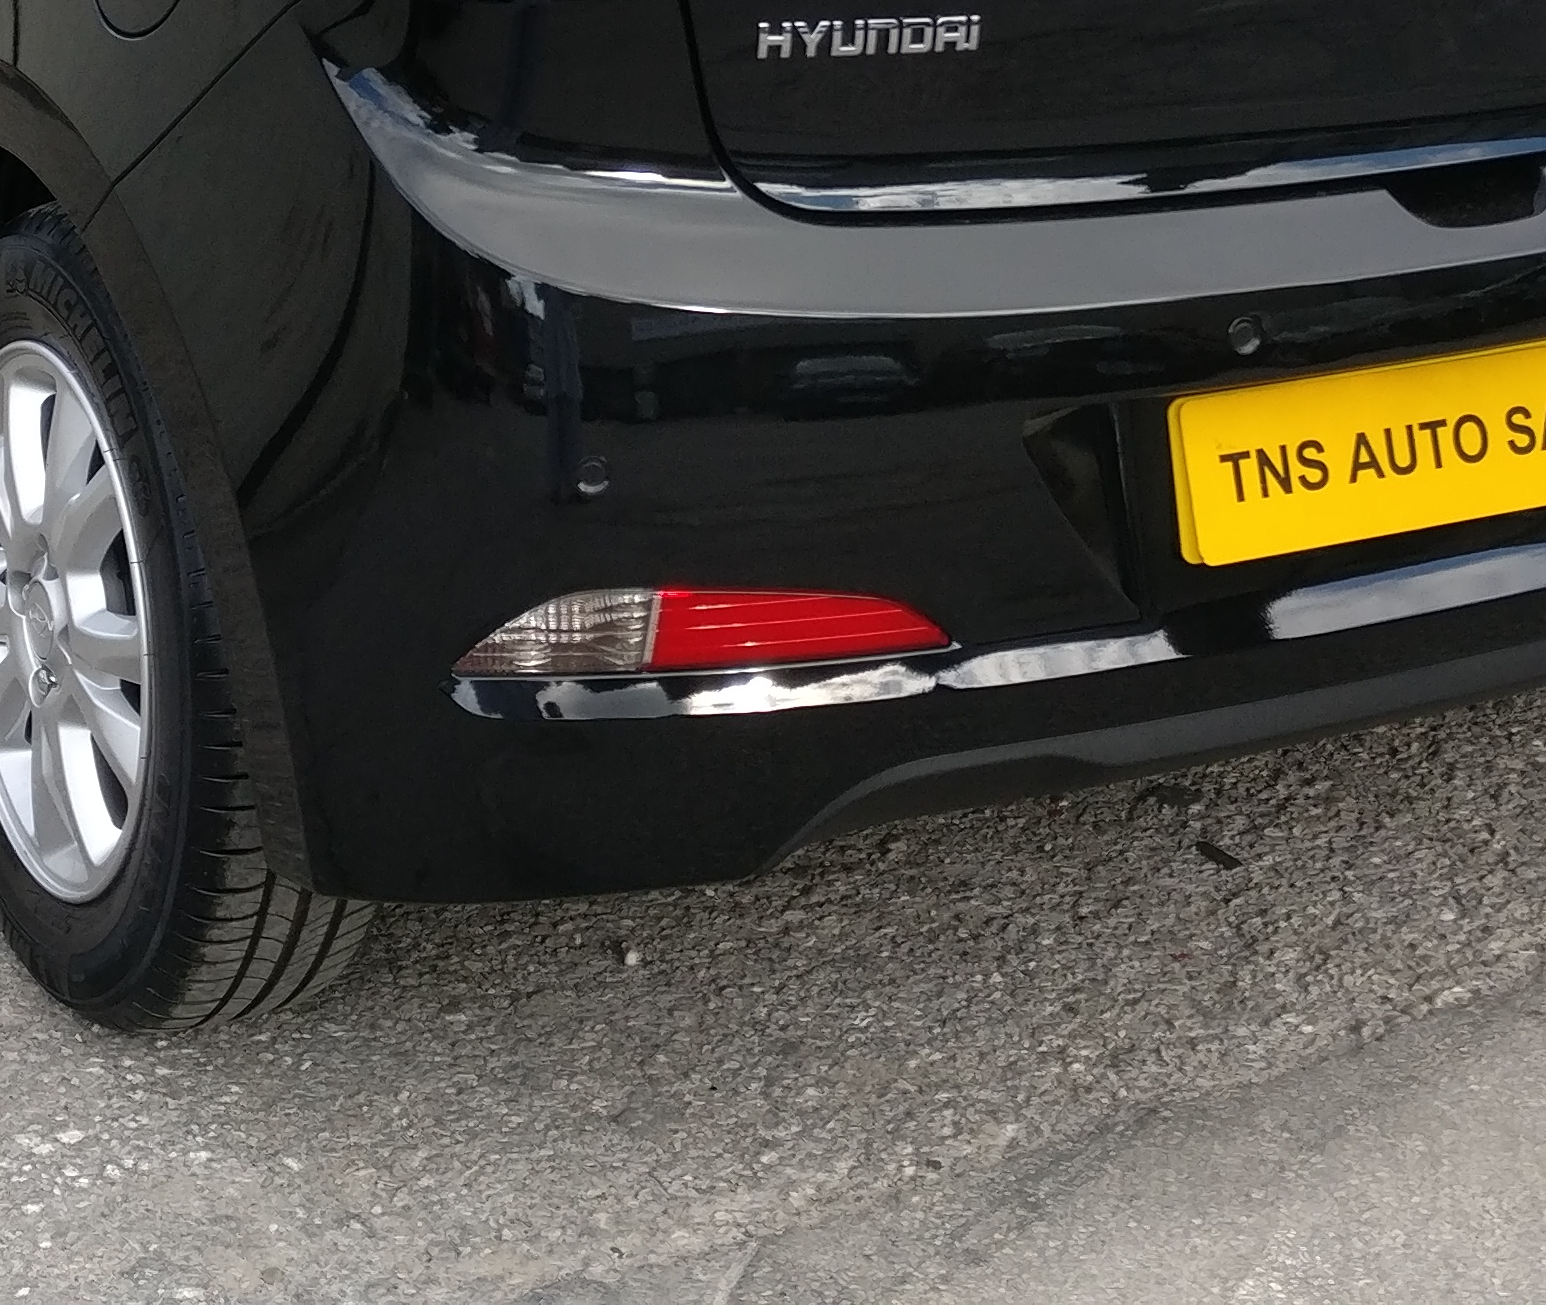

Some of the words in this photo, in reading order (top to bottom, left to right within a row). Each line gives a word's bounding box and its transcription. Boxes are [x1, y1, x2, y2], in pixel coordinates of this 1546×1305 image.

[756, 14, 983, 60] HYUNDAI
[27, 260, 138, 447] MICHELIN
[1219, 439, 1329, 503] TNS
[1349, 412, 1489, 485] AUTO
